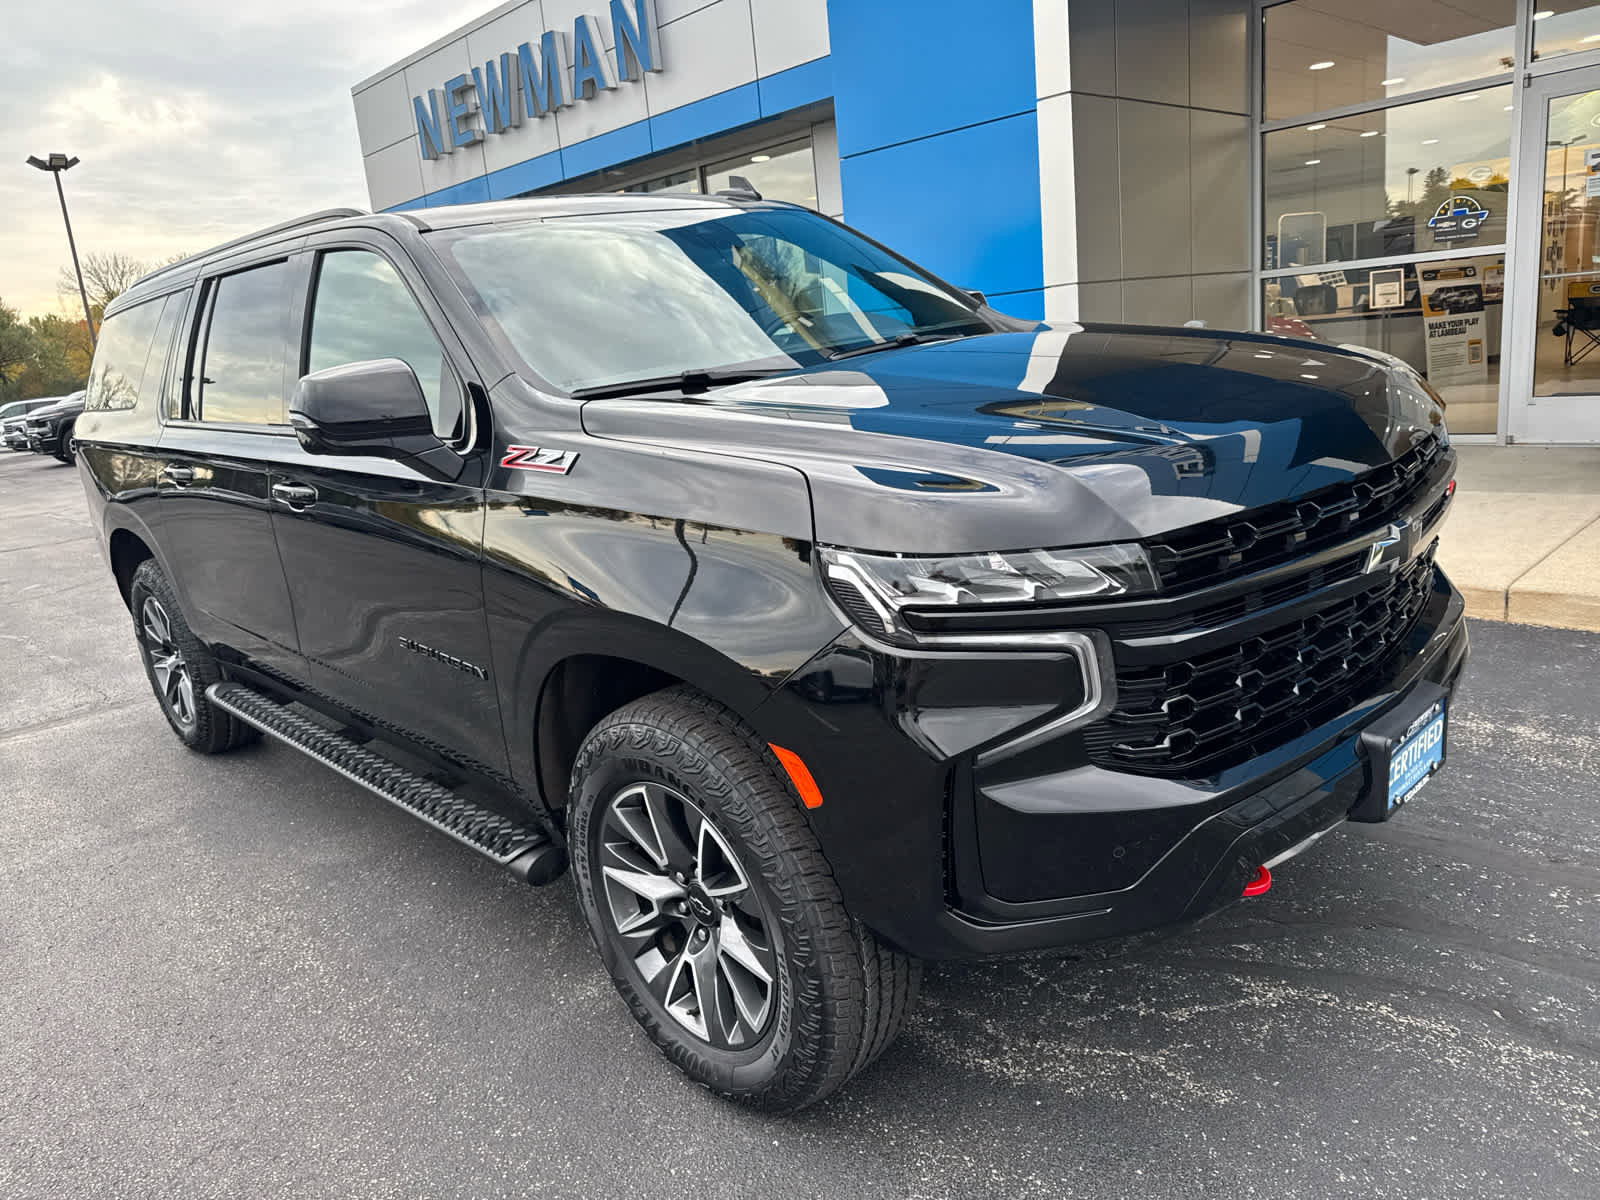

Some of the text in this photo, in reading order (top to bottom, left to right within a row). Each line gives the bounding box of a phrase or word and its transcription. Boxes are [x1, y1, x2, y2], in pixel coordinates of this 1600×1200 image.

[412, 0, 661, 160] NEWMAN
[1428, 317, 1480, 330] MAKE YOUR PLAY
[1429, 330, 1437, 338] AT
[501, 444, 579, 475] Z71
